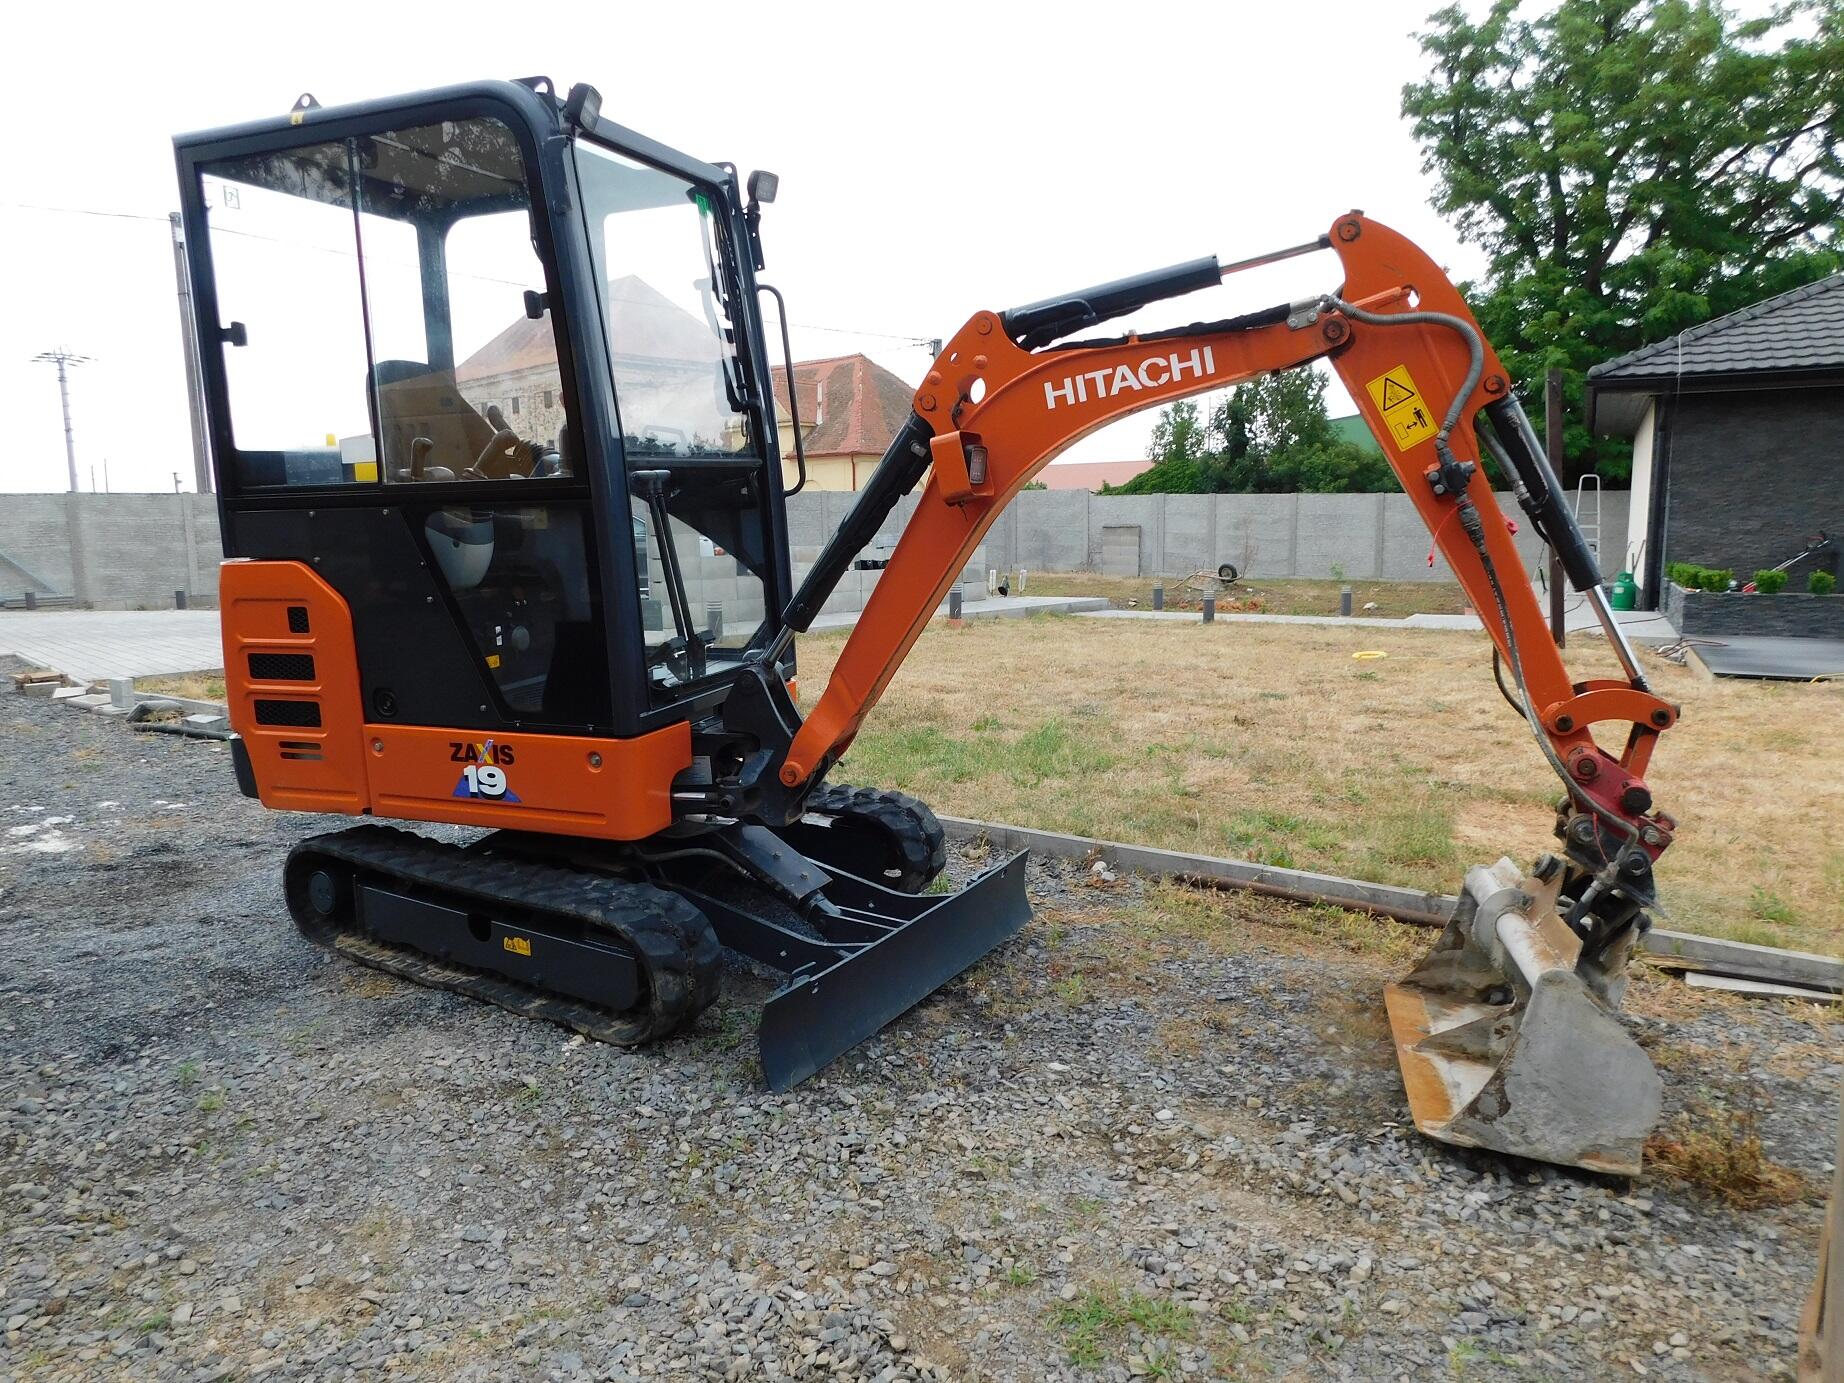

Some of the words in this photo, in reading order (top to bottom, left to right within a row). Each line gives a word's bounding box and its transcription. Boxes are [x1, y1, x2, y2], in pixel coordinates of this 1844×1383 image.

[1043, 345, 1216, 410] HITACHI
[449, 739, 515, 765] ZAXIS
[463, 764, 507, 797] 19
